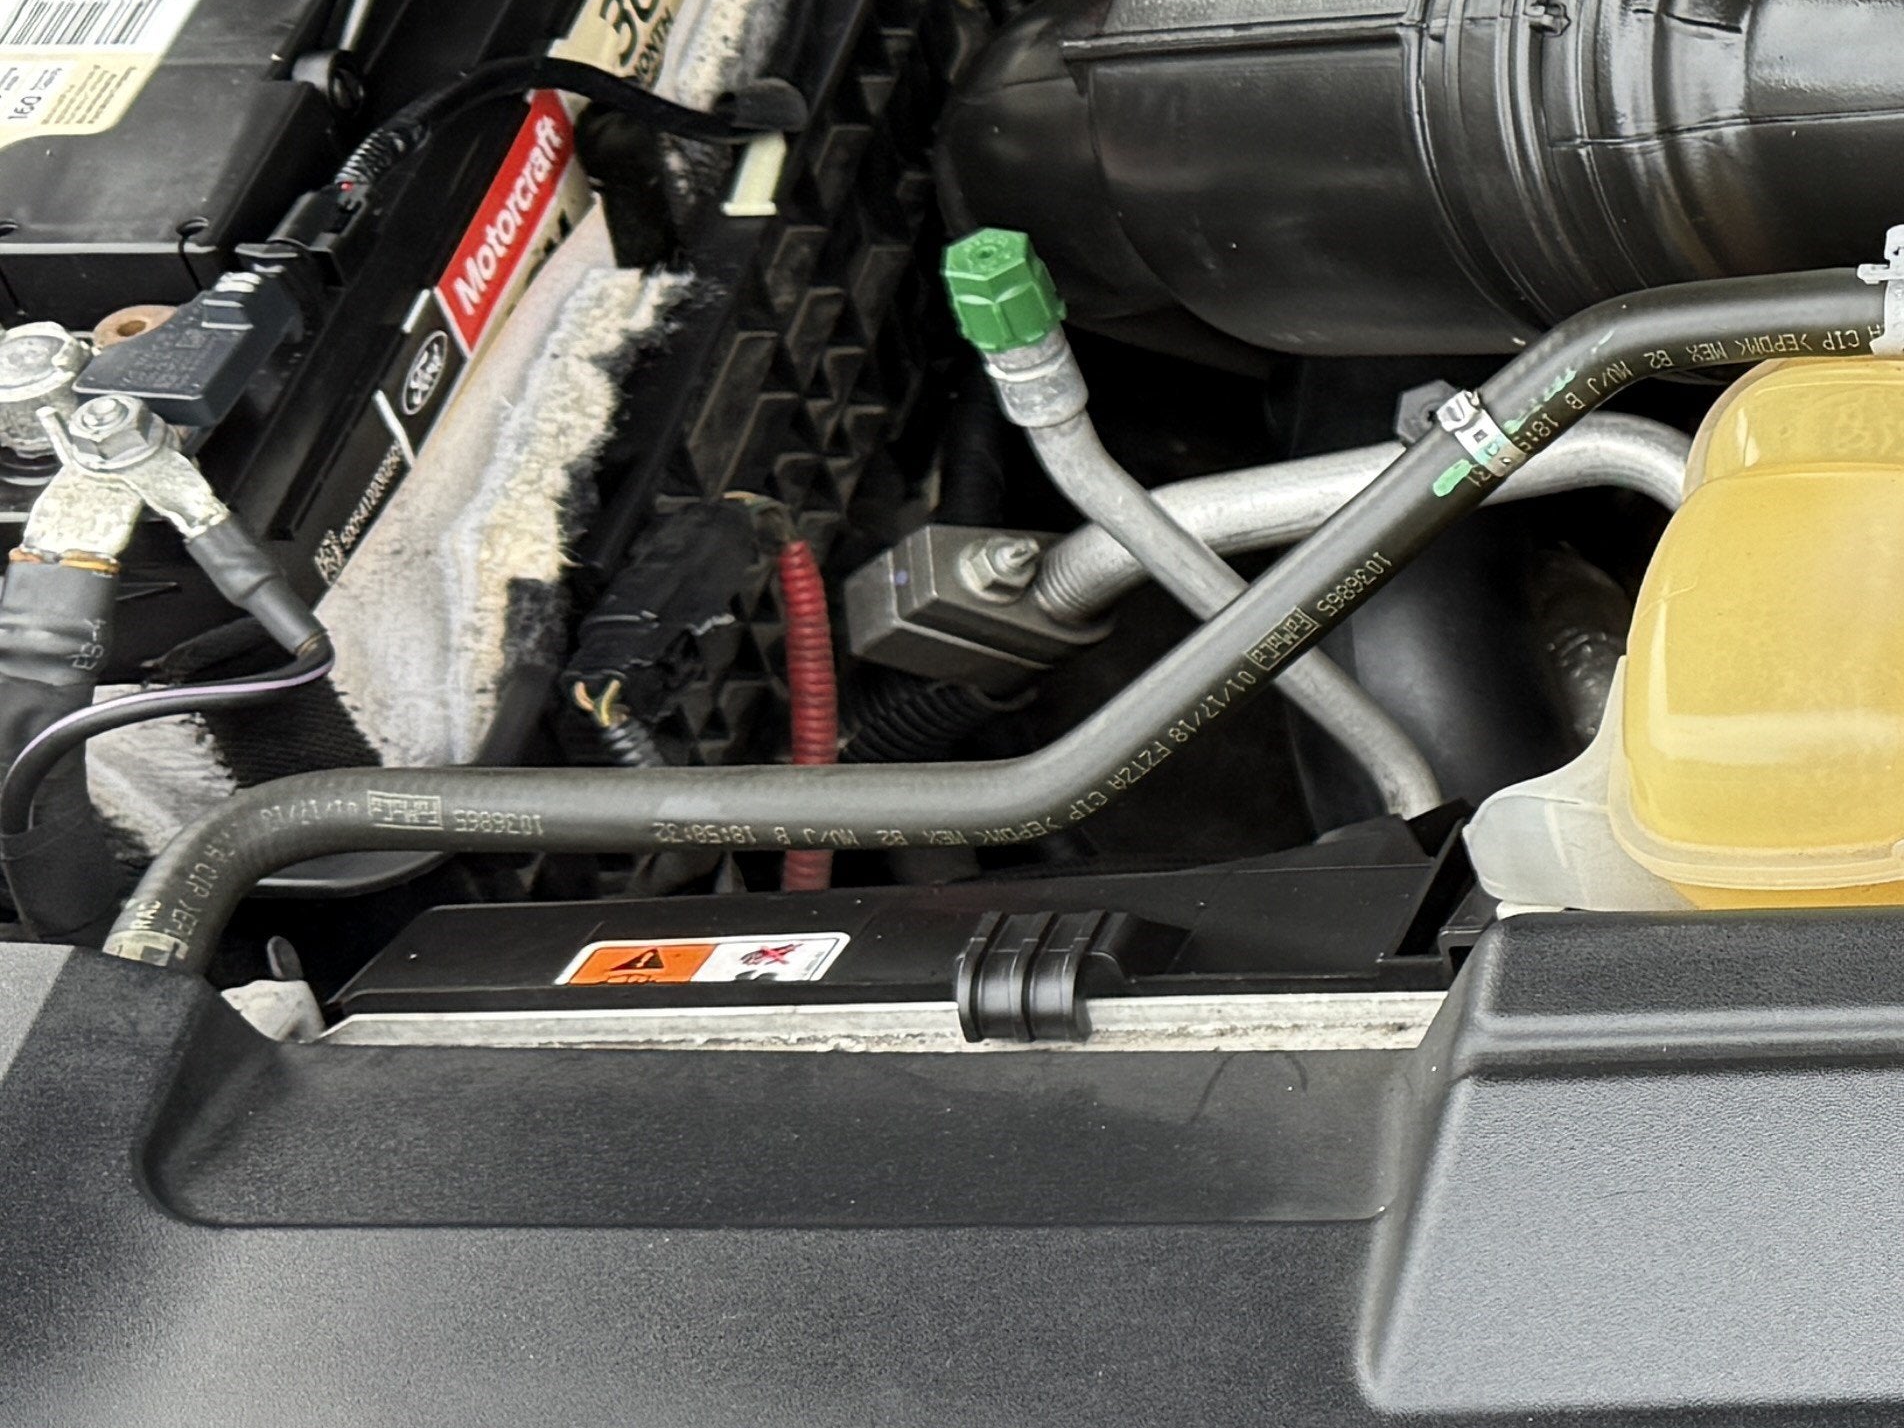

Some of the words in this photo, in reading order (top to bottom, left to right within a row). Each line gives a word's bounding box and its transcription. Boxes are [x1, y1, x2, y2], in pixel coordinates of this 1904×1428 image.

[453, 114, 563, 316] Motorcraft
[1685, 346, 1729, 364] MEX
[1821, 329, 1861, 351] CIP
[1316, 551, 1393, 617] 1036865
[1249, 611, 1316, 665] FoMoCo
[1168, 668, 1257, 743] 01/17/18
[1068, 790, 1108, 821] CIP
